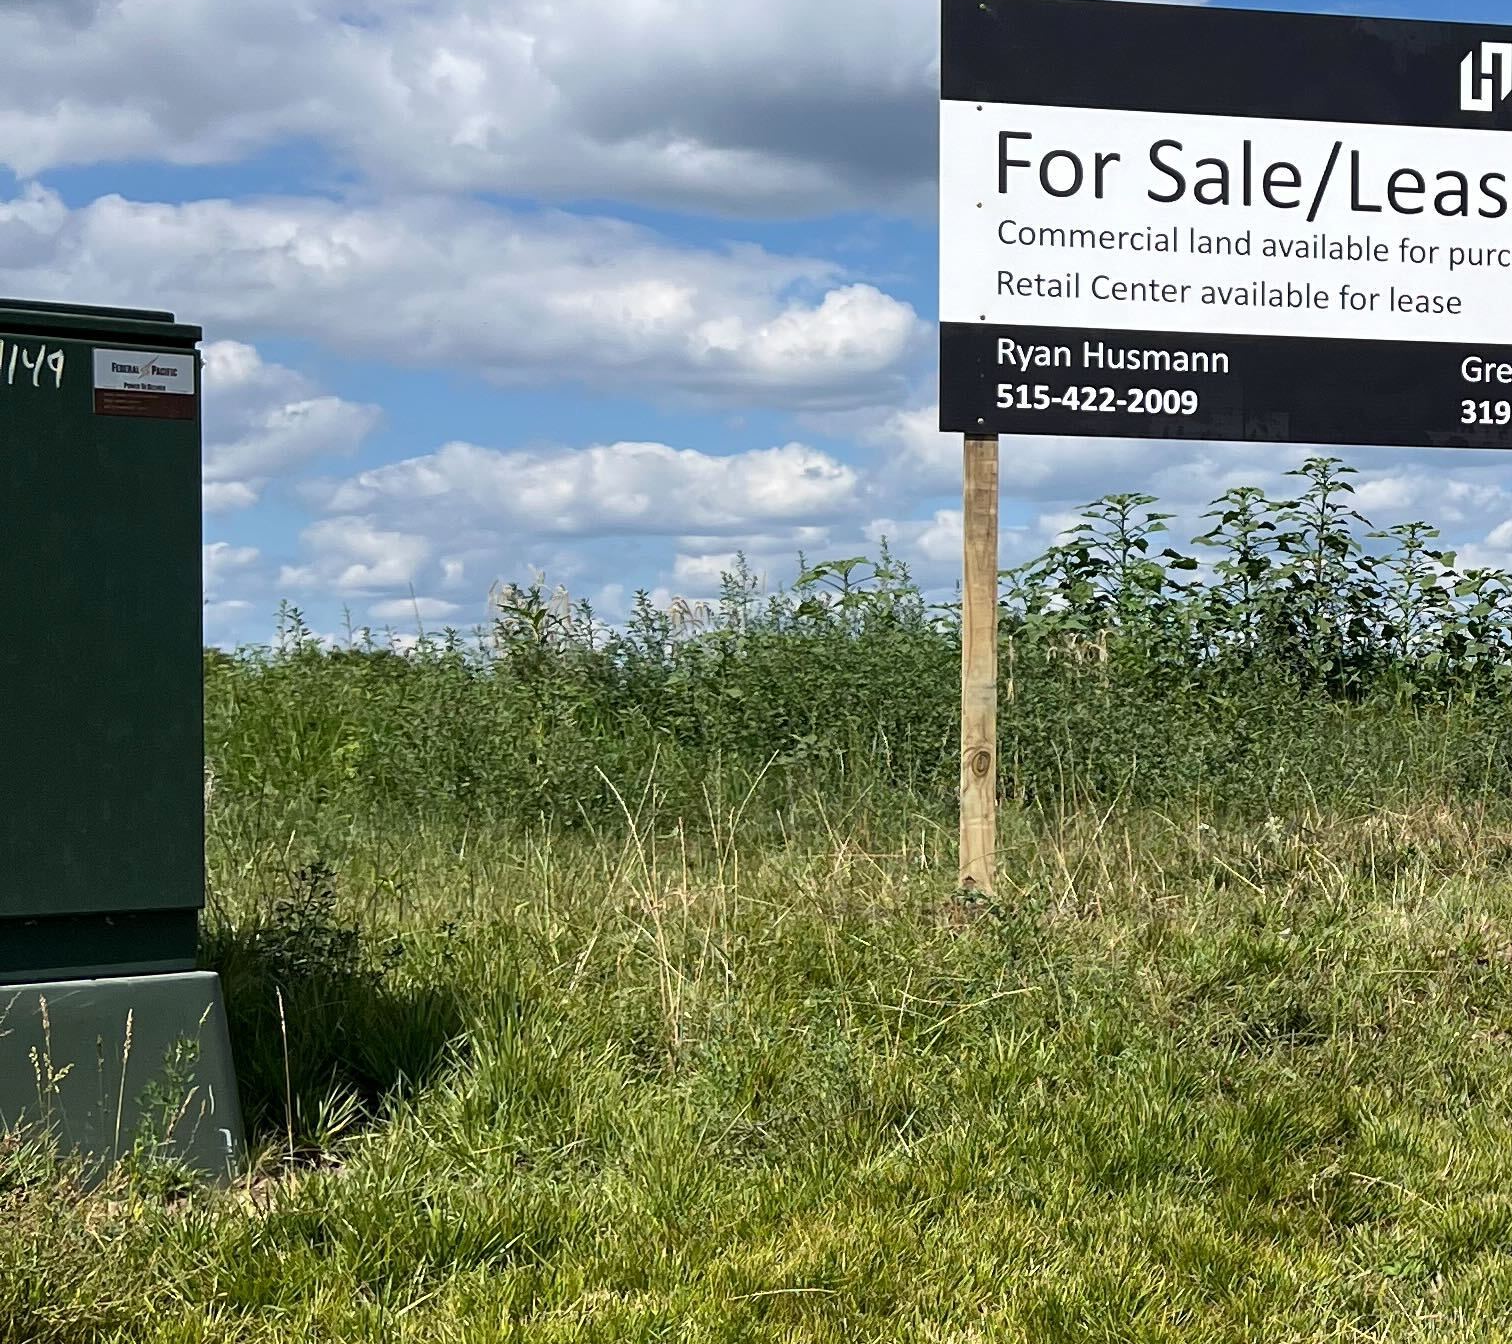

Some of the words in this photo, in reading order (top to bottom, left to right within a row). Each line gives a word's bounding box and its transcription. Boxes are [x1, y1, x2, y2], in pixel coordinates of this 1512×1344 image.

[998, 130, 1121, 199] For
[998, 219, 1179, 253] Commercial
[1190, 227, 1251, 256] land
[1262, 233, 1389, 262] available
[1398, 237, 1440, 264] for
[997, 270, 1080, 299] Retail
[1091, 274, 1192, 304] Center
[1201, 280, 1329, 310] available
[1338, 284, 1381, 312] for
[1390, 286, 1462, 315] lease
[0, 339, 65, 388] 149
[997, 337, 1071, 372] Ryan
[1083, 341, 1229, 374] Husmann
[996, 383, 1198, 415] 515-422-2009
